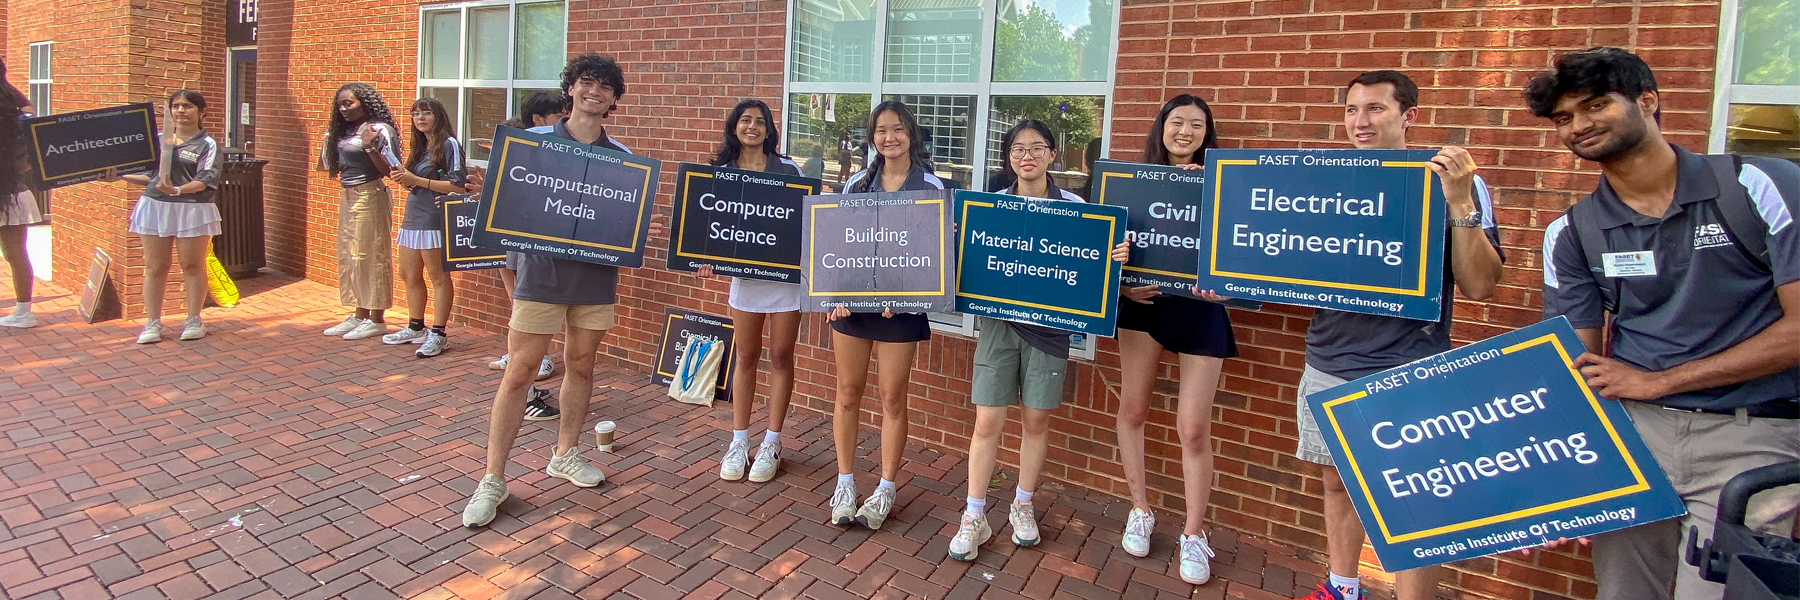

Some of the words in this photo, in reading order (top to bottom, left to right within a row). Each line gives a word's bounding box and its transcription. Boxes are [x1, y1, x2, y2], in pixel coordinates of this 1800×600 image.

[58, 114, 81, 123] FASET
[45, 133, 145, 157] Architecture
[541, 140, 571, 153] FASET
[573, 147, 621, 164] Orientation
[1258, 154, 1299, 166] FASET
[1302, 155, 1380, 167] Orientation
[508, 165, 638, 203] Computational
[715, 171, 739, 182] FASET
[741, 174, 784, 187] Orientation
[1136, 170, 1167, 181] FASET
[543, 197, 596, 220] Media
[699, 193, 794, 220] Computer
[840, 199, 866, 208] FASET
[866, 197, 913, 207] Orientation
[996, 200, 1025, 212] FASET
[1028, 203, 1079, 218] Orientation
[1148, 202, 1197, 222] Civil
[1250, 187, 1384, 217] Electrical
[709, 221, 777, 246] Science
[844, 227, 908, 246] Building
[971, 229, 1033, 252] Material
[1038, 238, 1100, 260] Science
[1232, 223, 1403, 266] Engineering
[500, 238, 532, 250] Georgia
[533, 243, 566, 254] Institute
[579, 250, 620, 262] Technology
[821, 252, 931, 269] Construction
[715, 264, 743, 273] Institute
[753, 268, 790, 280] Technology
[987, 255, 1078, 286] Engineering
[1139, 277, 1172, 288] Institute
[1173, 281, 1186, 289] Of
[850, 300, 880, 308] Institute
[881, 300, 892, 308] Of
[892, 300, 933, 309] Technology
[1224, 283, 1266, 296] Georgia
[1268, 288, 1314, 300] Institute
[1317, 292, 1335, 303] Of
[1335, 293, 1404, 312] Technology
[684, 314, 698, 322] FASET
[698, 316, 722, 326] Orientation
[968, 302, 997, 315] Georgia
[999, 307, 1031, 318] Institute
[1031, 311, 1043, 320] Of
[1043, 313, 1088, 329] Technology
[1365, 370, 1411, 396] FASET
[1413, 346, 1500, 382] Orientation
[1370, 386, 1548, 450] Computer
[1381, 430, 1599, 500] Engineering
[1413, 540, 1468, 560] Georgia
[1467, 527, 1529, 551] Institute
[1528, 522, 1549, 538] Of
[1549, 504, 1637, 534] Technology
